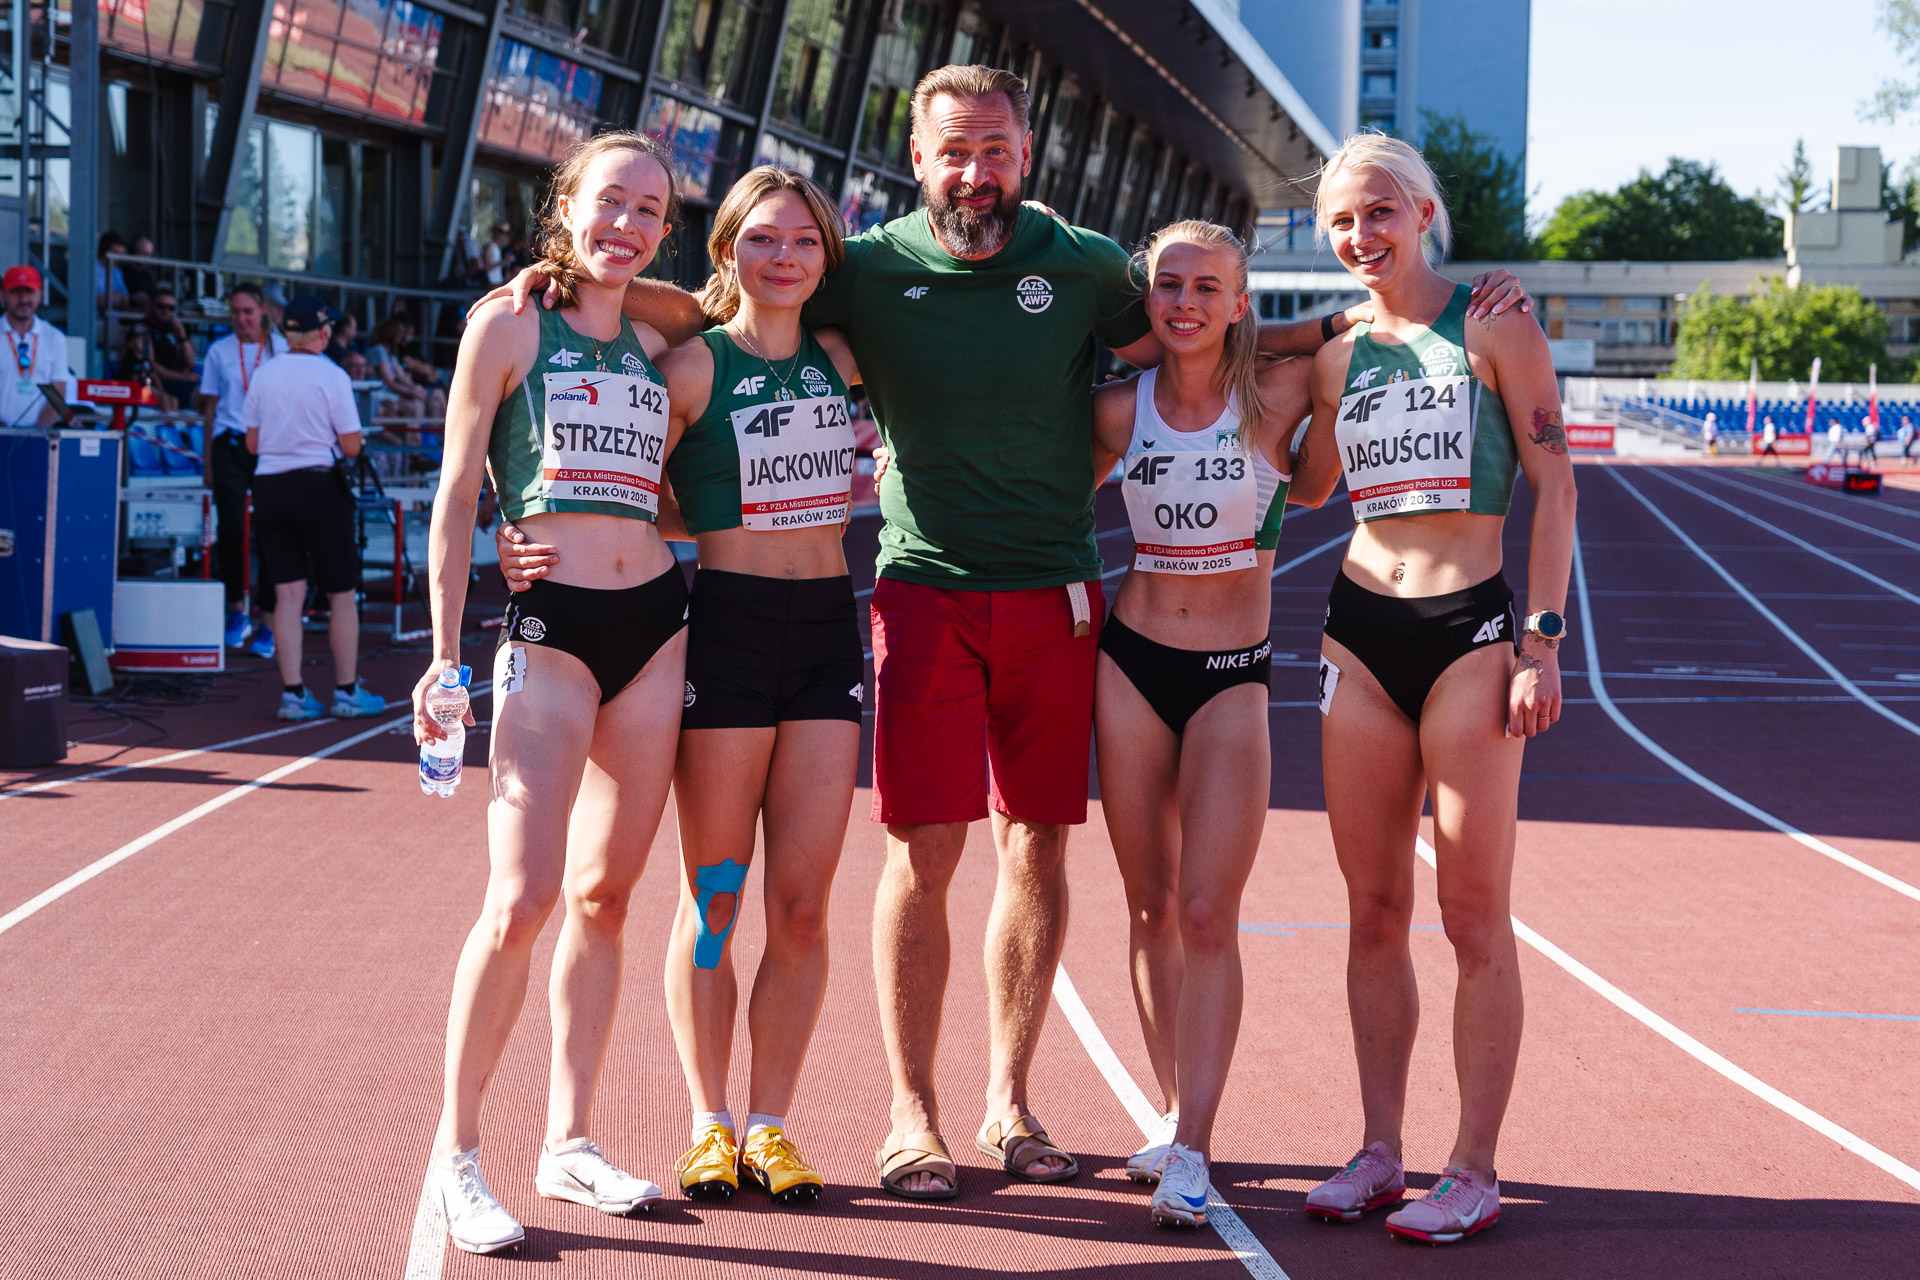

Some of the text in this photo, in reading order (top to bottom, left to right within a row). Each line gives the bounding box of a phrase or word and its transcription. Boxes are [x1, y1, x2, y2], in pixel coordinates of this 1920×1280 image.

[904, 286, 930, 299] 4F
[1024, 281, 1045, 290] AZS
[1024, 295, 1048, 305] AWF
[549, 348, 583, 368] 4F
[1428, 347, 1450, 360] AZS
[805, 371, 821, 380] AZS
[1350, 366, 1382, 389] 4F
[1425, 363, 1452, 377] AWF
[732, 376, 766, 396] 4F
[809, 384, 829, 393] AWF
[550, 384, 663, 415] polanik 142
[1343, 384, 1456, 423] 4F 124
[744, 403, 847, 438] 4F 123
[552, 422, 663, 466] STRZEŻYSZ
[1347, 429, 1464, 473] JAGUŚCIK
[747, 447, 854, 487] JACKOWICZ
[1127, 456, 1245, 485] 4F 133
[558, 470, 570, 479] 42.
[572, 471, 591, 480] PZLA
[593, 472, 635, 484] Mistrzostwa
[573, 485, 648, 504] KRAKÓW 2025
[1376, 482, 1414, 495] Mistrzostwa
[1415, 479, 1440, 488] Polski
[1441, 479, 1458, 487] U23
[756, 504, 768, 512] 42.
[770, 503, 788, 511] PZLA
[789, 498, 829, 509] Mistrzostwa
[1367, 494, 1441, 513] KRAKÓW 2025
[772, 508, 845, 527] KRAKÓW 2025
[1154, 502, 1218, 529] OKO
[1153, 546, 1165, 554] PZLA
[1166, 547, 1206, 555] Mistrzostwa
[1208, 544, 1229, 554] Polski
[1230, 541, 1244, 550] U23
[1154, 557, 1232, 571] KRAKÓW 2025
[1472, 613, 1505, 643] 4F
[1206, 652, 1250, 669] NIKE
